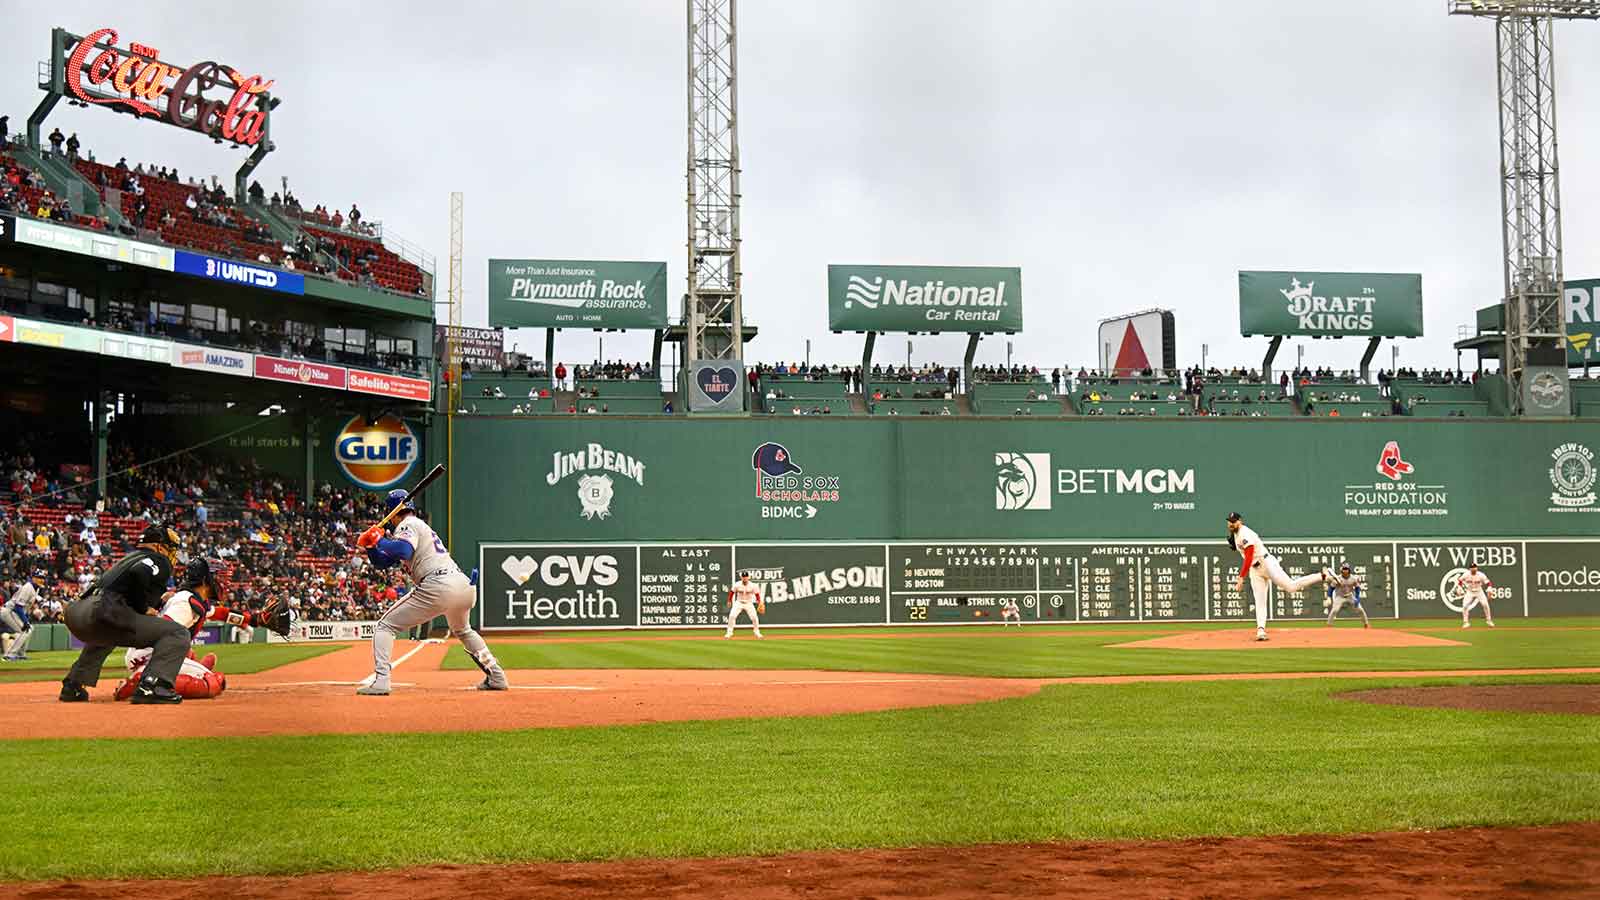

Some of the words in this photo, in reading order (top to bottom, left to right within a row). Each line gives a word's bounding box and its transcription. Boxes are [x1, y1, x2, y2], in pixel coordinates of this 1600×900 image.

[130, 42, 160, 60] ENJOY
[222, 266, 278, 288] UNITED
[505, 266, 526, 275] More
[527, 266, 545, 275] Than
[545, 266, 560, 276] Just
[511, 277, 596, 300] Plymouth
[600, 279, 645, 299] Rock
[1287, 295, 1376, 316] DRAFT
[926, 309, 950, 321] Car
[955, 309, 1000, 321] Rental
[1298, 312, 1373, 330] KINGS
[205, 353, 244, 368] AMAZING
[273, 363, 298, 377] Ninety
[711, 374, 721, 383] EL
[256, 436, 288, 447] starts
[338, 436, 414, 461] Gulf
[1551, 442, 1577, 460] IBEW
[1577, 445, 1595, 461] 103
[546, 450, 585, 486] JIM
[587, 443, 645, 486] BEAM
[763, 476, 798, 489] RED
[803, 476, 839, 489] SOX
[1058, 469, 1195, 494] BETMGM
[591, 488, 600, 497] B
[761, 489, 839, 501] SCHOLARS
[1345, 492, 1447, 504] FOUNDATION
[761, 506, 802, 519] BIDMC
[681, 549, 710, 557] EAST
[926, 548, 988, 556] FENWAY
[1000, 547, 1039, 555] PARK
[1404, 547, 1442, 567] F.W.
[1448, 546, 1516, 567] WEBB
[686, 563, 693, 571] W
[699, 563, 705, 571] L
[708, 563, 721, 571] GB
[905, 558, 911, 566] P
[948, 558, 951, 566] 1
[954, 558, 961, 566] 2
[963, 558, 969, 566] 3
[973, 558, 980, 566] 4
[982, 558, 988, 566] 5
[989, 558, 996, 566] 6
[1000, 558, 1006, 566] 7
[1008, 558, 1014, 566] 8
[1016, 558, 1022, 566] 9
[1026, 558, 1035, 566] 10
[540, 555, 619, 586] CVS
[739, 570, 762, 579] HO
[764, 569, 783, 579] BUT
[641, 575, 657, 583] NEW
[659, 575, 679, 583] YORK
[684, 575, 695, 583] 28
[698, 575, 706, 583] 19
[914, 580, 944, 588] BOSTON
[641, 585, 673, 593] BOSTON
[684, 585, 695, 593] 25
[697, 585, 708, 593] 25
[711, 585, 718, 593] 4
[1406, 588, 1436, 600] Since
[505, 590, 620, 619] Health
[641, 595, 678, 603] TORONTO
[685, 595, 695, 603] 23
[697, 595, 708, 603] 24
[711, 595, 718, 603] 5
[828, 596, 857, 604] SINCE
[859, 596, 881, 604] 1898
[937, 598, 958, 606] BALL
[967, 598, 995, 606] STRIKE
[910, 606, 927, 619] 22
[641, 616, 682, 624] BALTIMORE
[685, 616, 694, 624] 16
[697, 616, 708, 624] 32
[710, 616, 719, 624] 12
[309, 624, 334, 635] TRULY
